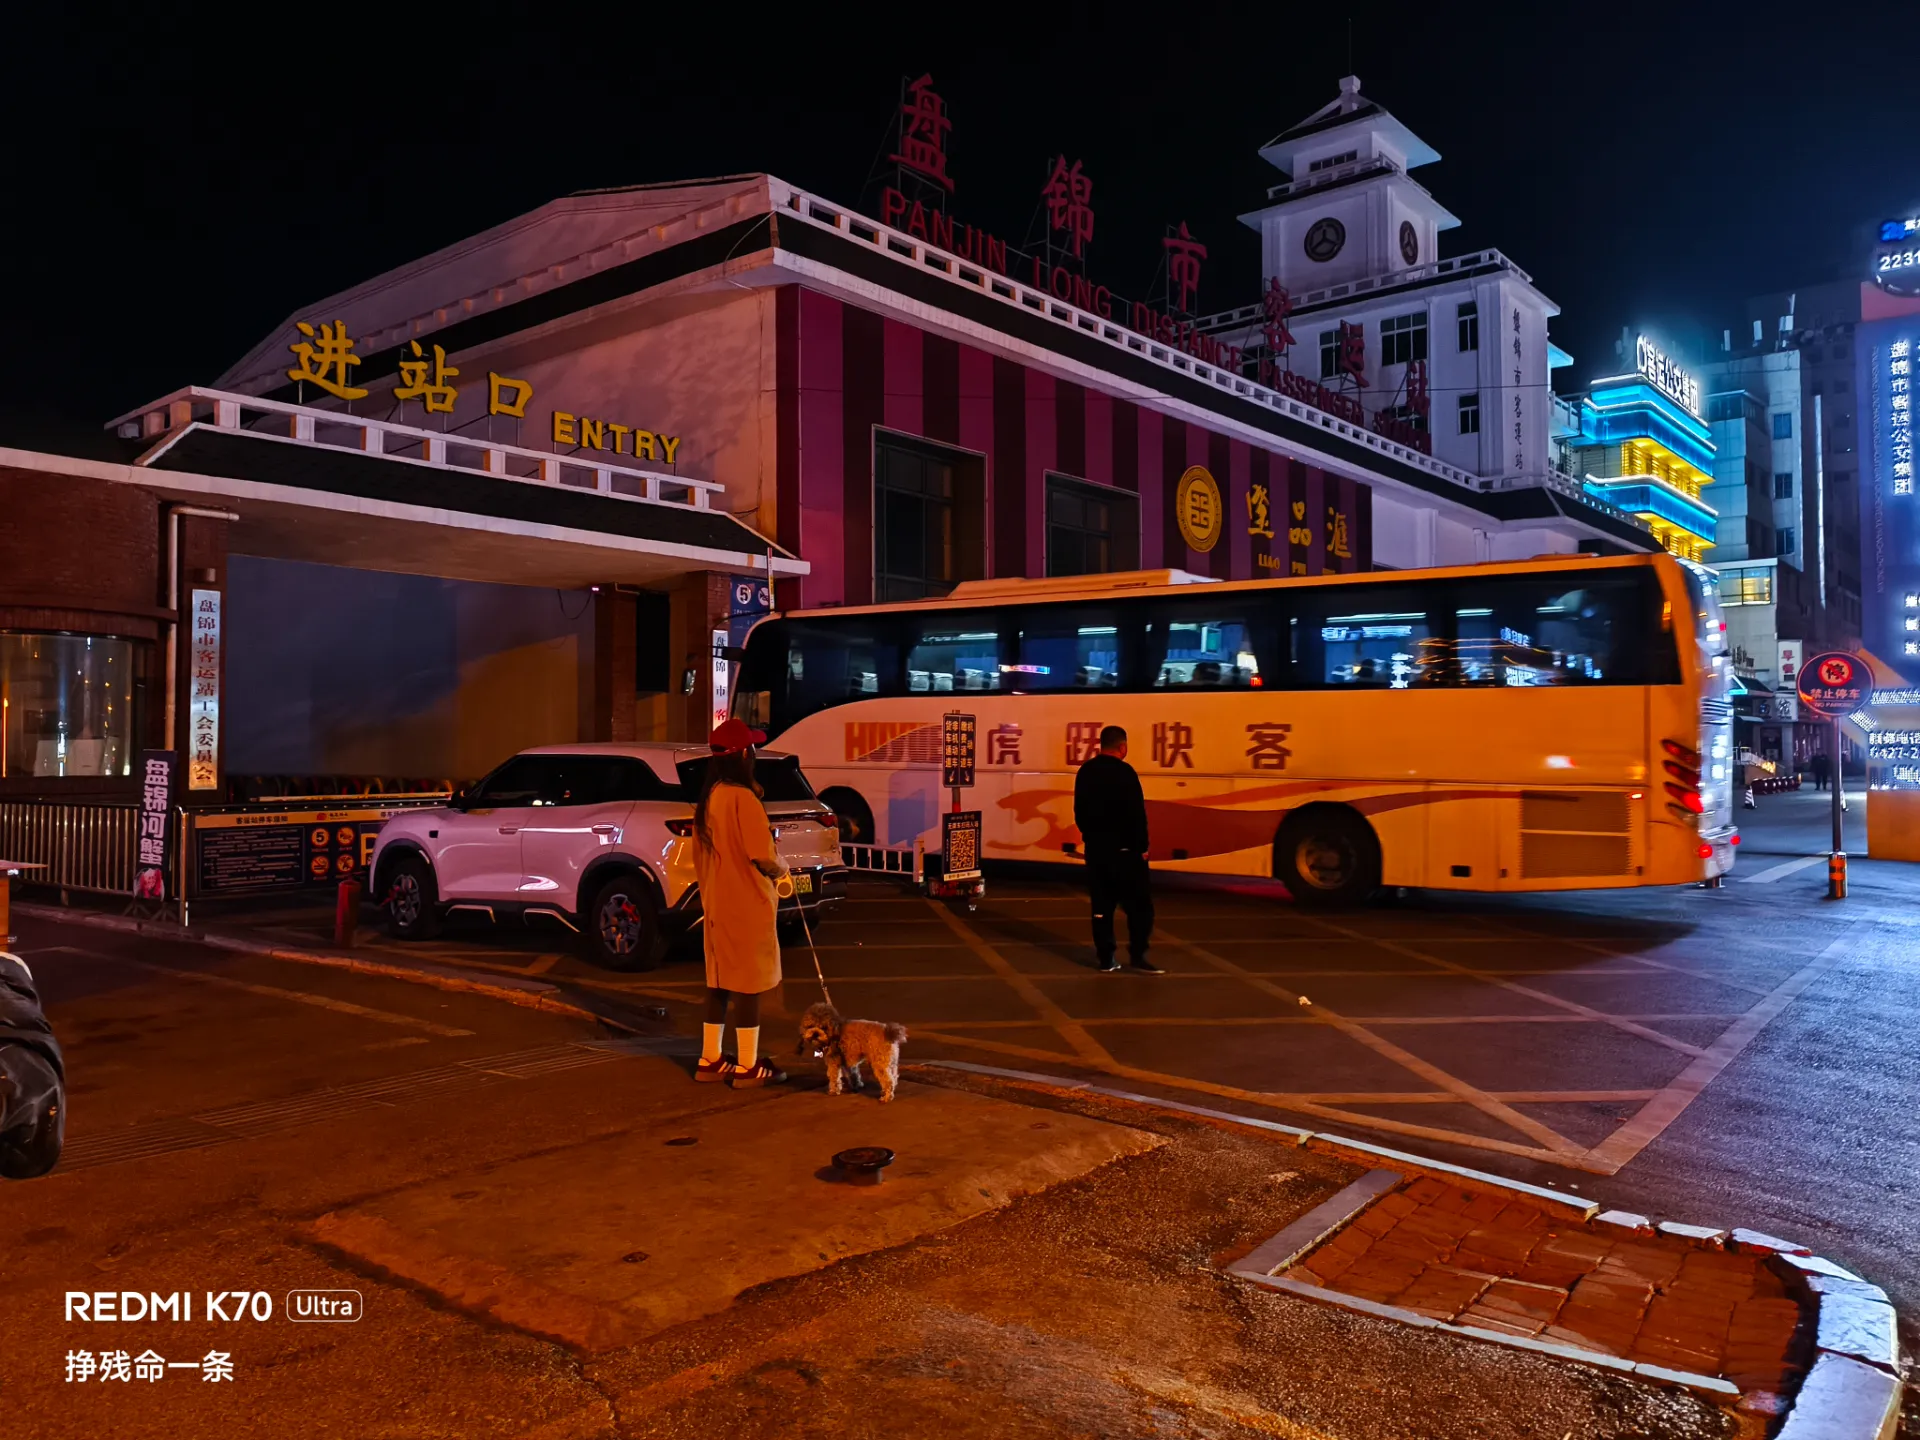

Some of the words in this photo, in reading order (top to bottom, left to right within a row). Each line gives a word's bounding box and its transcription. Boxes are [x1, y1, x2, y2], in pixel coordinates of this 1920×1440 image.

[882, 186, 1006, 276] PANJIN
[1032, 255, 1112, 318] LONG
[1132, 300, 1243, 374] DISTANCE
[286, 319, 534, 418] 进站口
[552, 411, 681, 464] ENTRY
[740, 587, 748, 601] 5
[195, 599, 216, 781] 盘锦市客运站工会委员会
[1810, 688, 1860, 699] 禁止停车
[316, 832, 325, 843] 5
